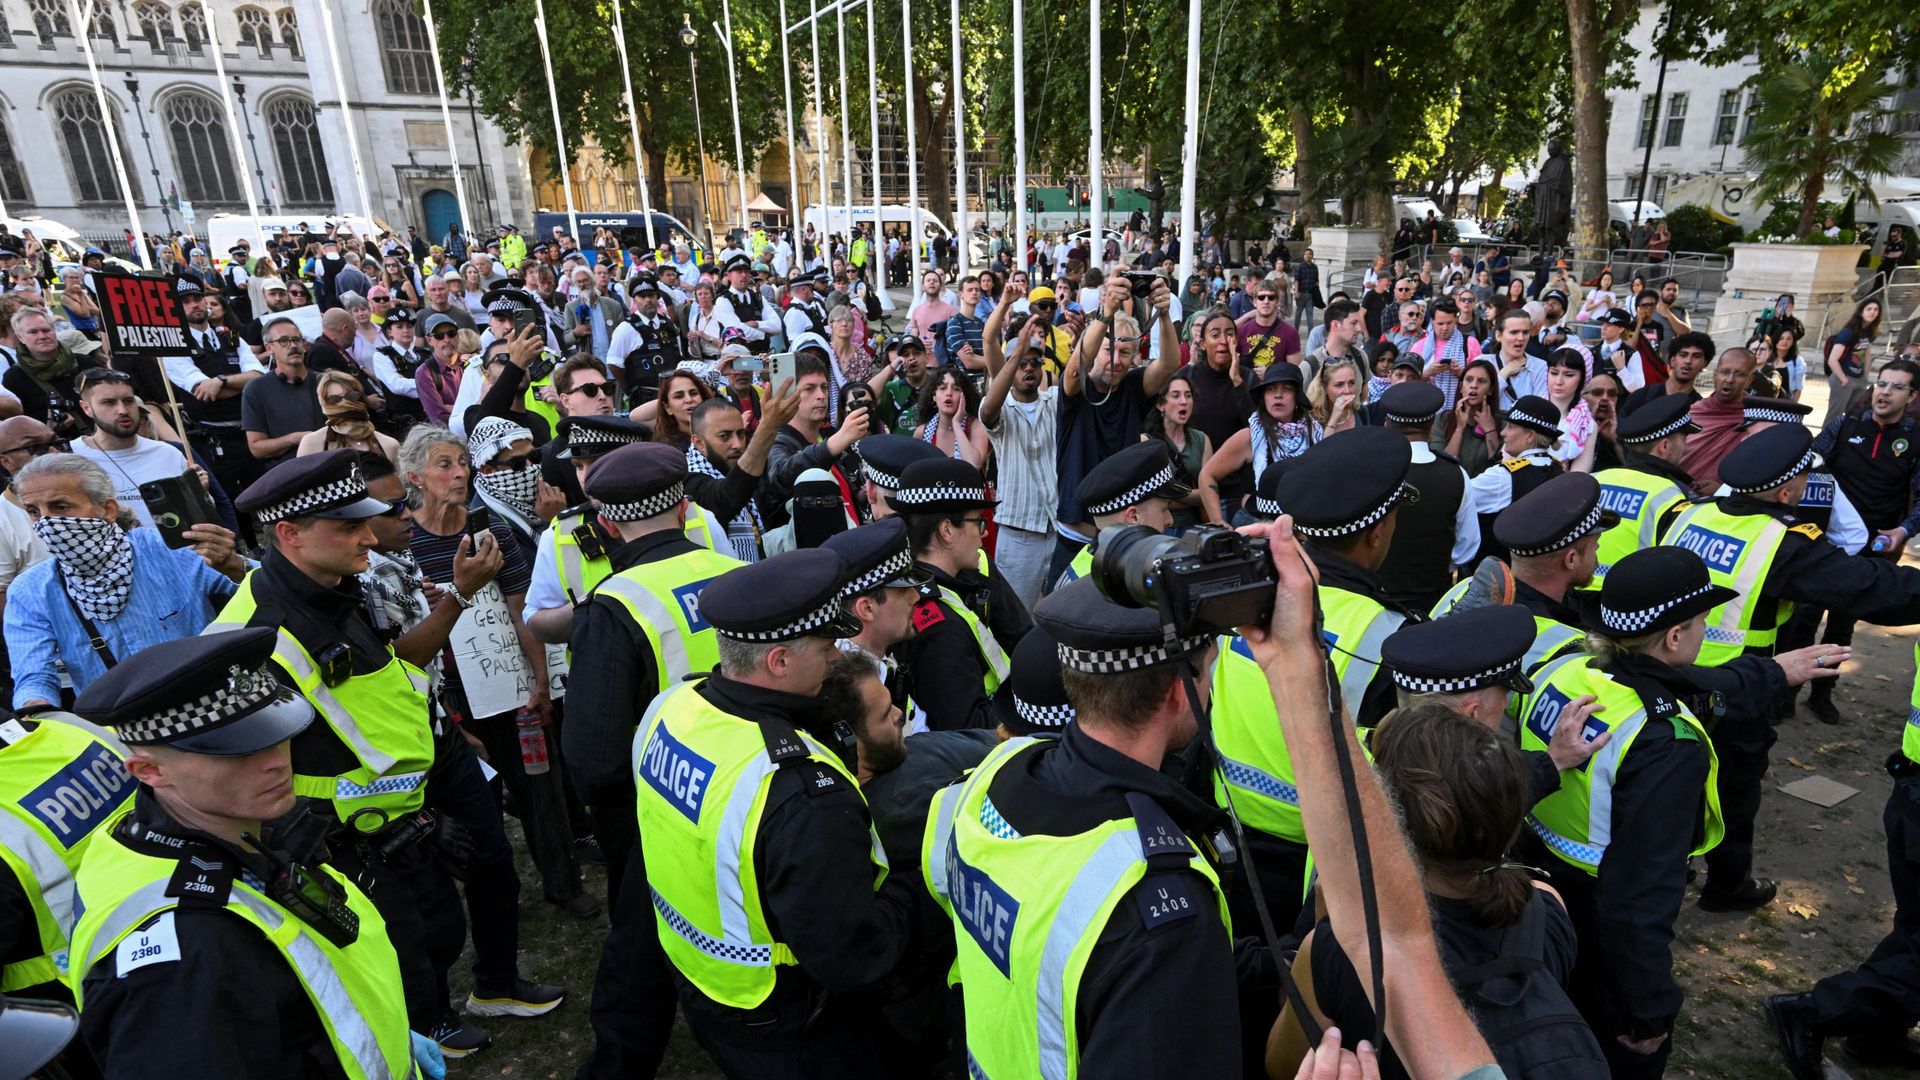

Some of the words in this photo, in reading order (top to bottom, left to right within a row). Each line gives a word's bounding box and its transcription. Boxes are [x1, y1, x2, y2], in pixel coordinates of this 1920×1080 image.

[103, 277, 181, 326] FREE
[116, 325, 187, 347] PALESTINE
[1801, 486, 1832, 501] LICE
[1600, 489, 1642, 515] OLICE
[1677, 529, 1738, 567] POLICE
[1655, 702, 1673, 714] 2471
[1656, 697, 1664, 705] U
[775, 745, 800, 755] 2850
[643, 730, 706, 811] POLICE
[816, 777, 834, 788] 2850
[35, 750, 132, 835] POLICE
[1156, 826, 1166, 835] U
[145, 830, 186, 848] POLICE
[1147, 836, 1185, 847] 2408
[197, 875, 207, 883] U
[183, 882, 215, 893] 2380
[1158, 887, 1168, 899] U
[946, 840, 1010, 960] POLICE
[1150, 897, 1189, 917] 2408
[141, 937, 149, 947] U
[131, 945, 161, 961] 2380
